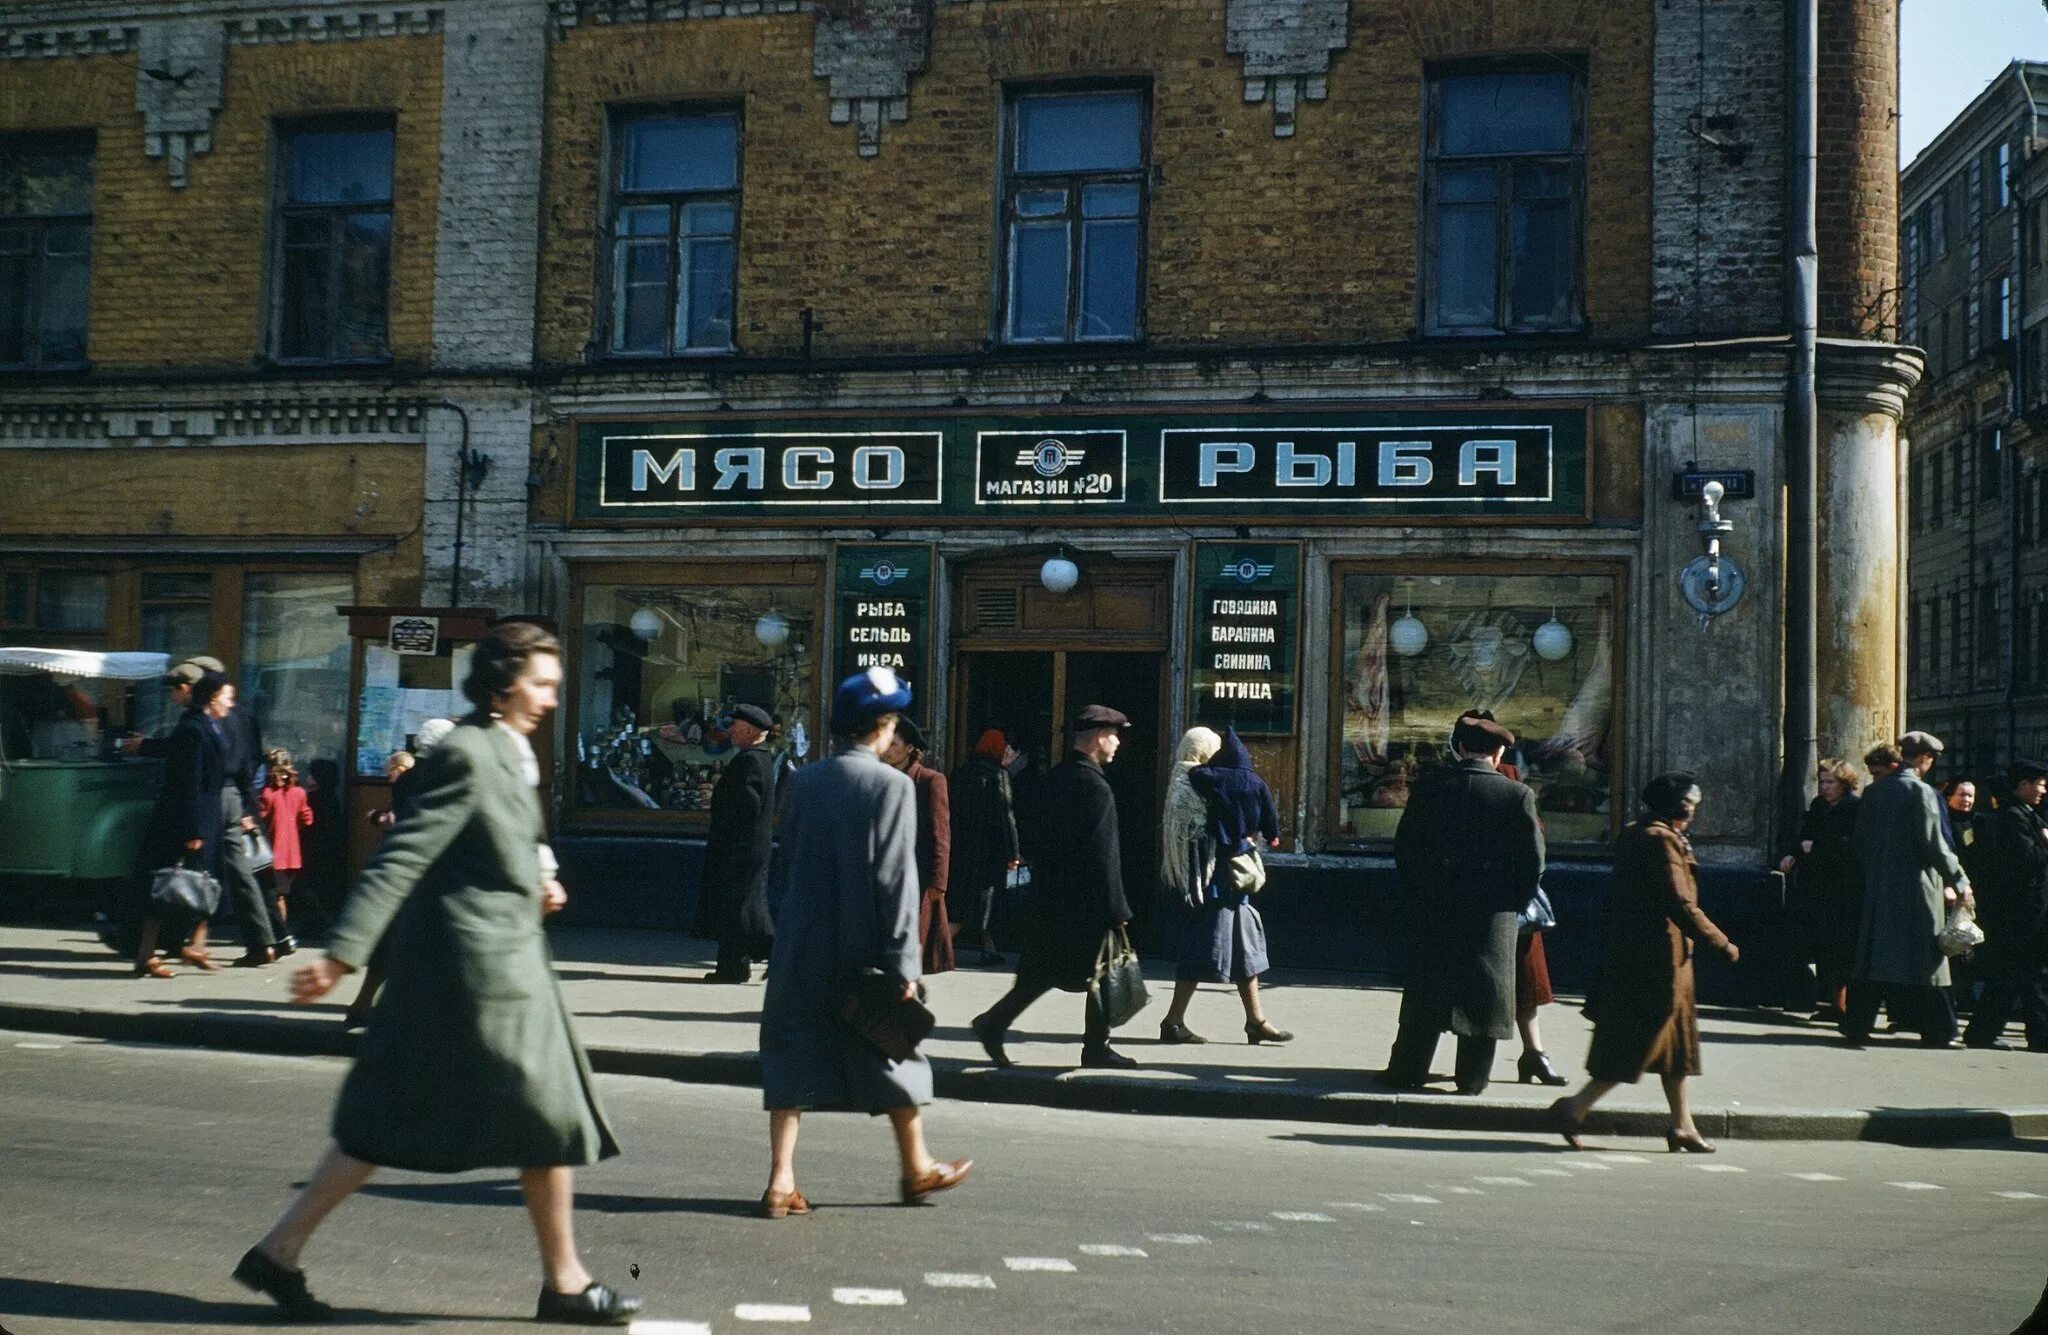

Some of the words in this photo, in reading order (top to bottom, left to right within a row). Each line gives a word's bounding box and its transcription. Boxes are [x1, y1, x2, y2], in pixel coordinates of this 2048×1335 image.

[632, 446, 905, 491] МЯСО
[1199, 440, 1517, 487] РЫБА
[986, 479, 1069, 496] МАГАЗИН
[856, 602, 906, 617] РЫБА
[1212, 599, 1278, 616] ГОВЯДИНА
[850, 627, 911, 643] СЕЛЬДЬ
[1211, 626, 1275, 643] БАРАНИНА
[857, 653, 905, 667] ИКРА
[1214, 653, 1271, 670] СВИНИНА
[1214, 681, 1272, 700] ПТИЦА
